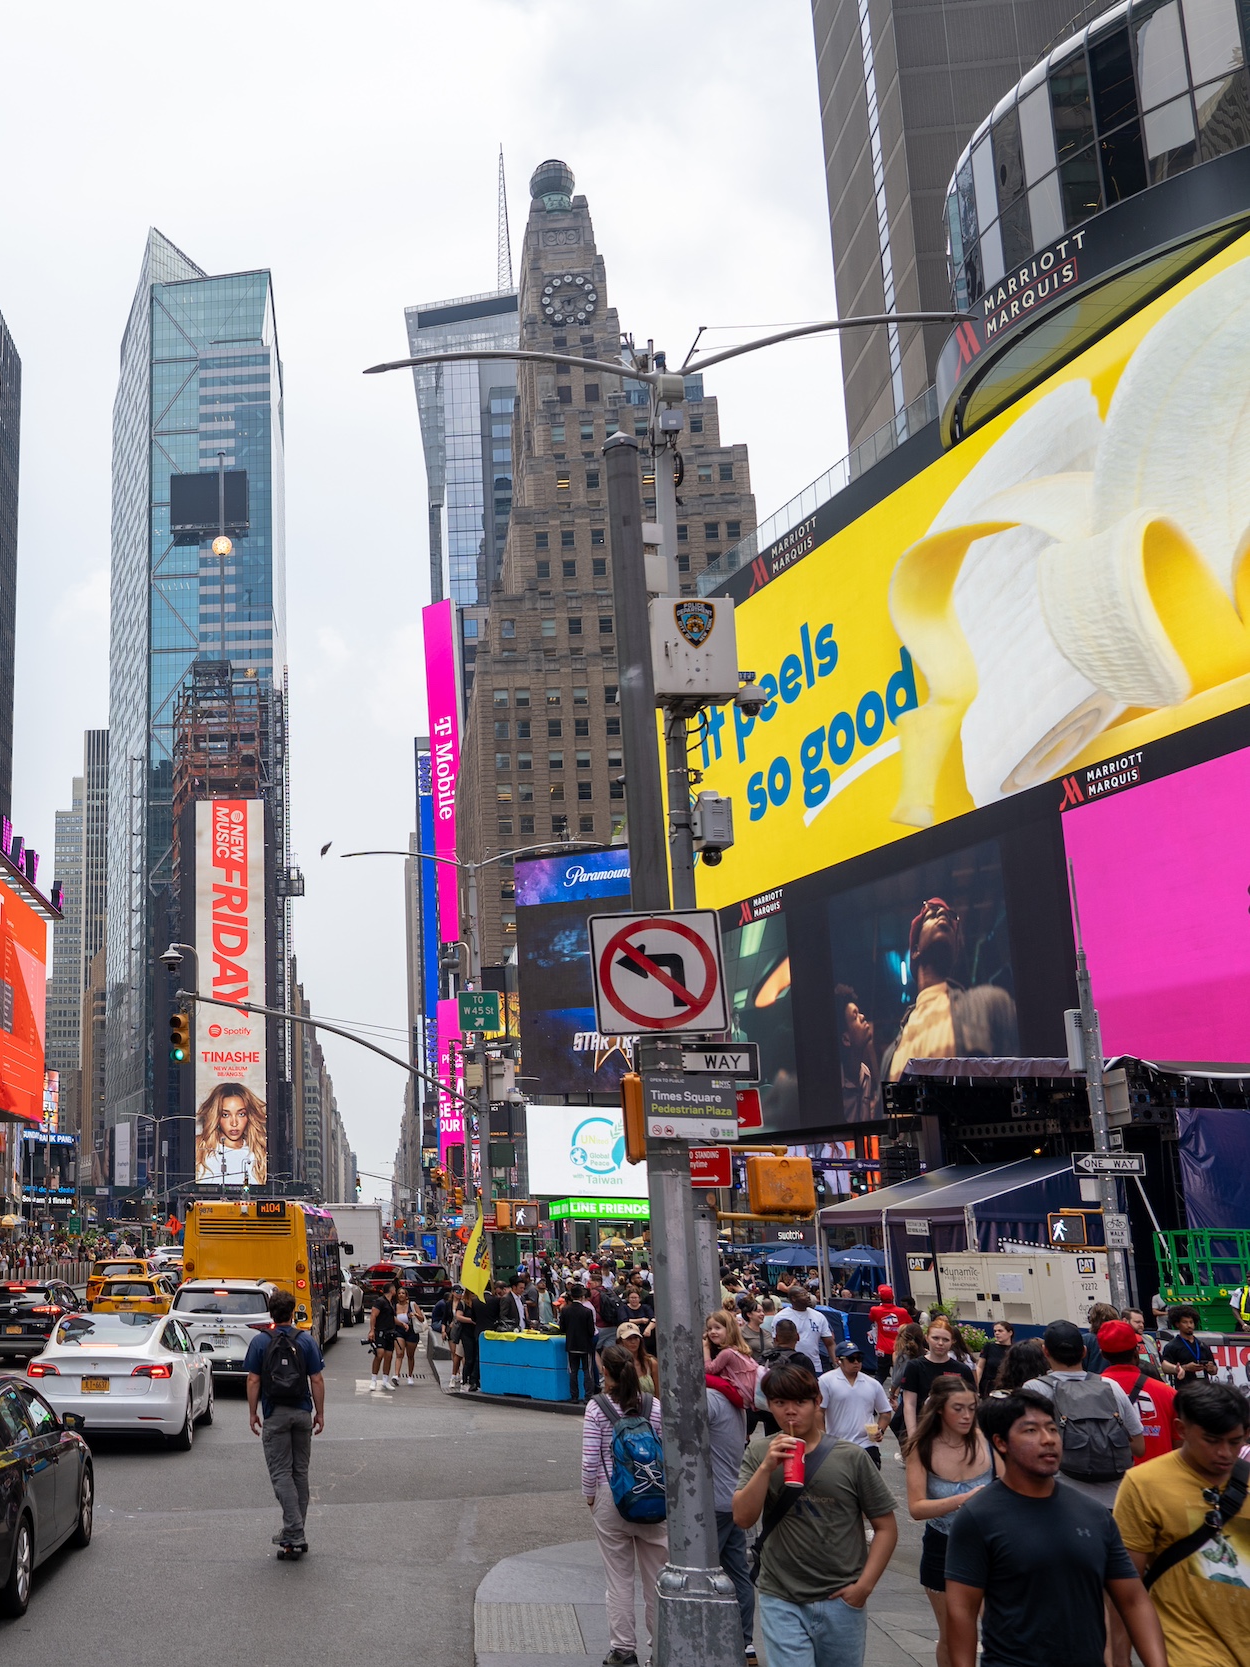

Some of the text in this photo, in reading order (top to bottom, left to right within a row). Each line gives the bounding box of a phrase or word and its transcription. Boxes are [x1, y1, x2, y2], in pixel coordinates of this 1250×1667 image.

[984, 230, 1086, 316] MARRIOTT
[986, 264, 1074, 338] MARQUIS
[771, 516, 817, 559] MARRIOTT
[772, 536, 813, 574] MARQUIS
[676, 607, 712, 616] DEPARTMENT
[747, 645, 919, 821] so good
[1086, 752, 1144, 782] MARRIOTT
[436, 740, 455, 820] Mobile
[1088, 769, 1138, 796] MARQUIS
[216, 806, 230, 859] MUSIC
[230, 824, 244, 863] NEW
[753, 889, 783, 907] MARRIOTT
[754, 901, 780, 917] MARQUIS
[212, 866, 249, 1019] FRIDAY
[473, 995, 483, 1004] TO
[223, 1027, 251, 1036] Spotify
[573, 1031, 610, 1051] STAR
[202, 1051, 260, 1063] TINASHE
[704, 1055, 741, 1070] WAY
[650, 1090, 721, 1104] Times Square
[651, 1103, 732, 1116] Pedestrian Plaza
[581, 1135, 609, 1145] UNited
[695, 1150, 719, 1159] STANDING
[1084, 1159, 1135, 1168] ONE WAY
[586, 1174, 623, 1185] Taiwan
[260, 1203, 281, 1213] M104
[570, 1202, 597, 1213] LINE
[599, 1203, 649, 1215] FRIENDS
[464, 1213, 475, 1221] 25
[778, 1230, 800, 1240] swatch
[909, 1258, 925, 1271] CAT
[1078, 1261, 1095, 1272] CAT
[944, 1267, 978, 1281] dynamic
[1081, 1283, 1098, 1291] Y2272
[809, 1318, 819, 1332] LA
